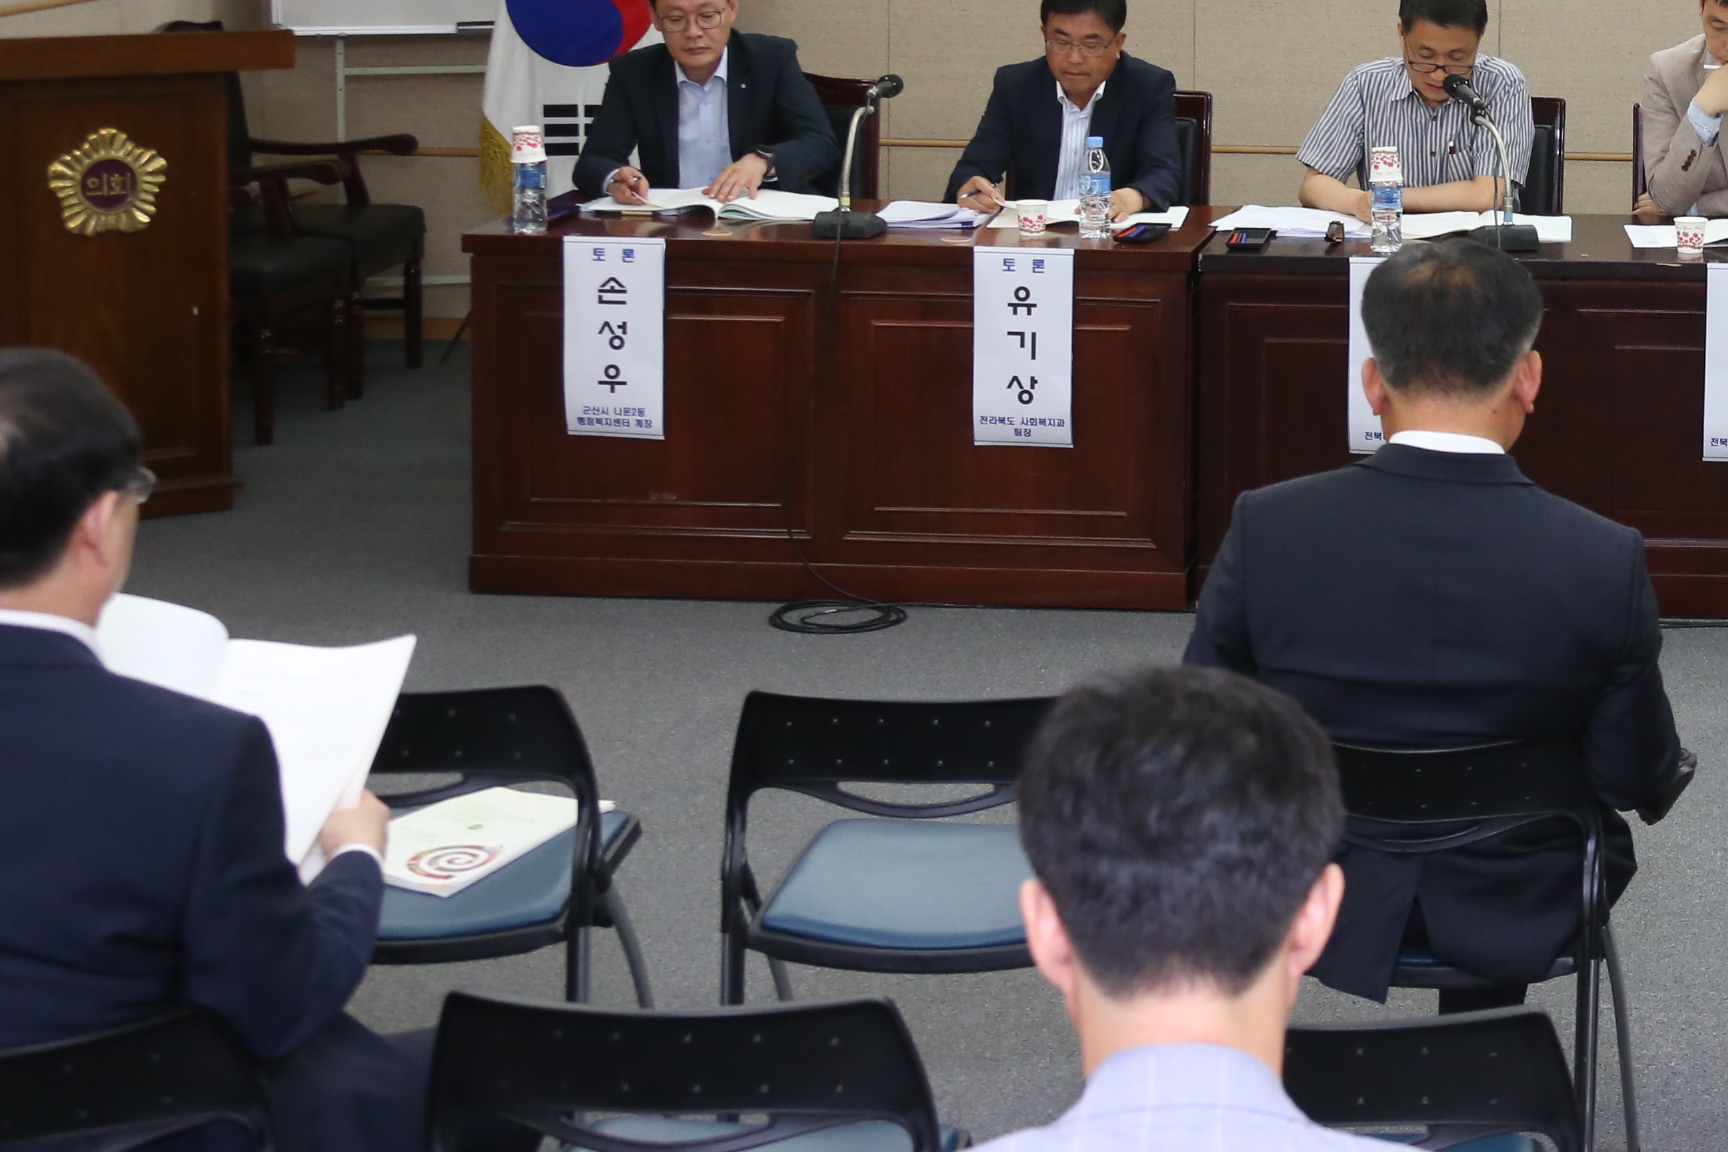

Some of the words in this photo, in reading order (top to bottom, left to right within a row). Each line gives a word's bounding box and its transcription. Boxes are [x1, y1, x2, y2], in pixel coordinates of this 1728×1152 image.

[85, 172, 132, 197] 의회
[597, 276, 628, 394] 손성우
[1007, 285, 1039, 405] 유기상
[979, 415, 1016, 426] 전라북도
[1020, 416, 1066, 428] 사회복지과
[1014, 427, 1032, 438] 팀장
